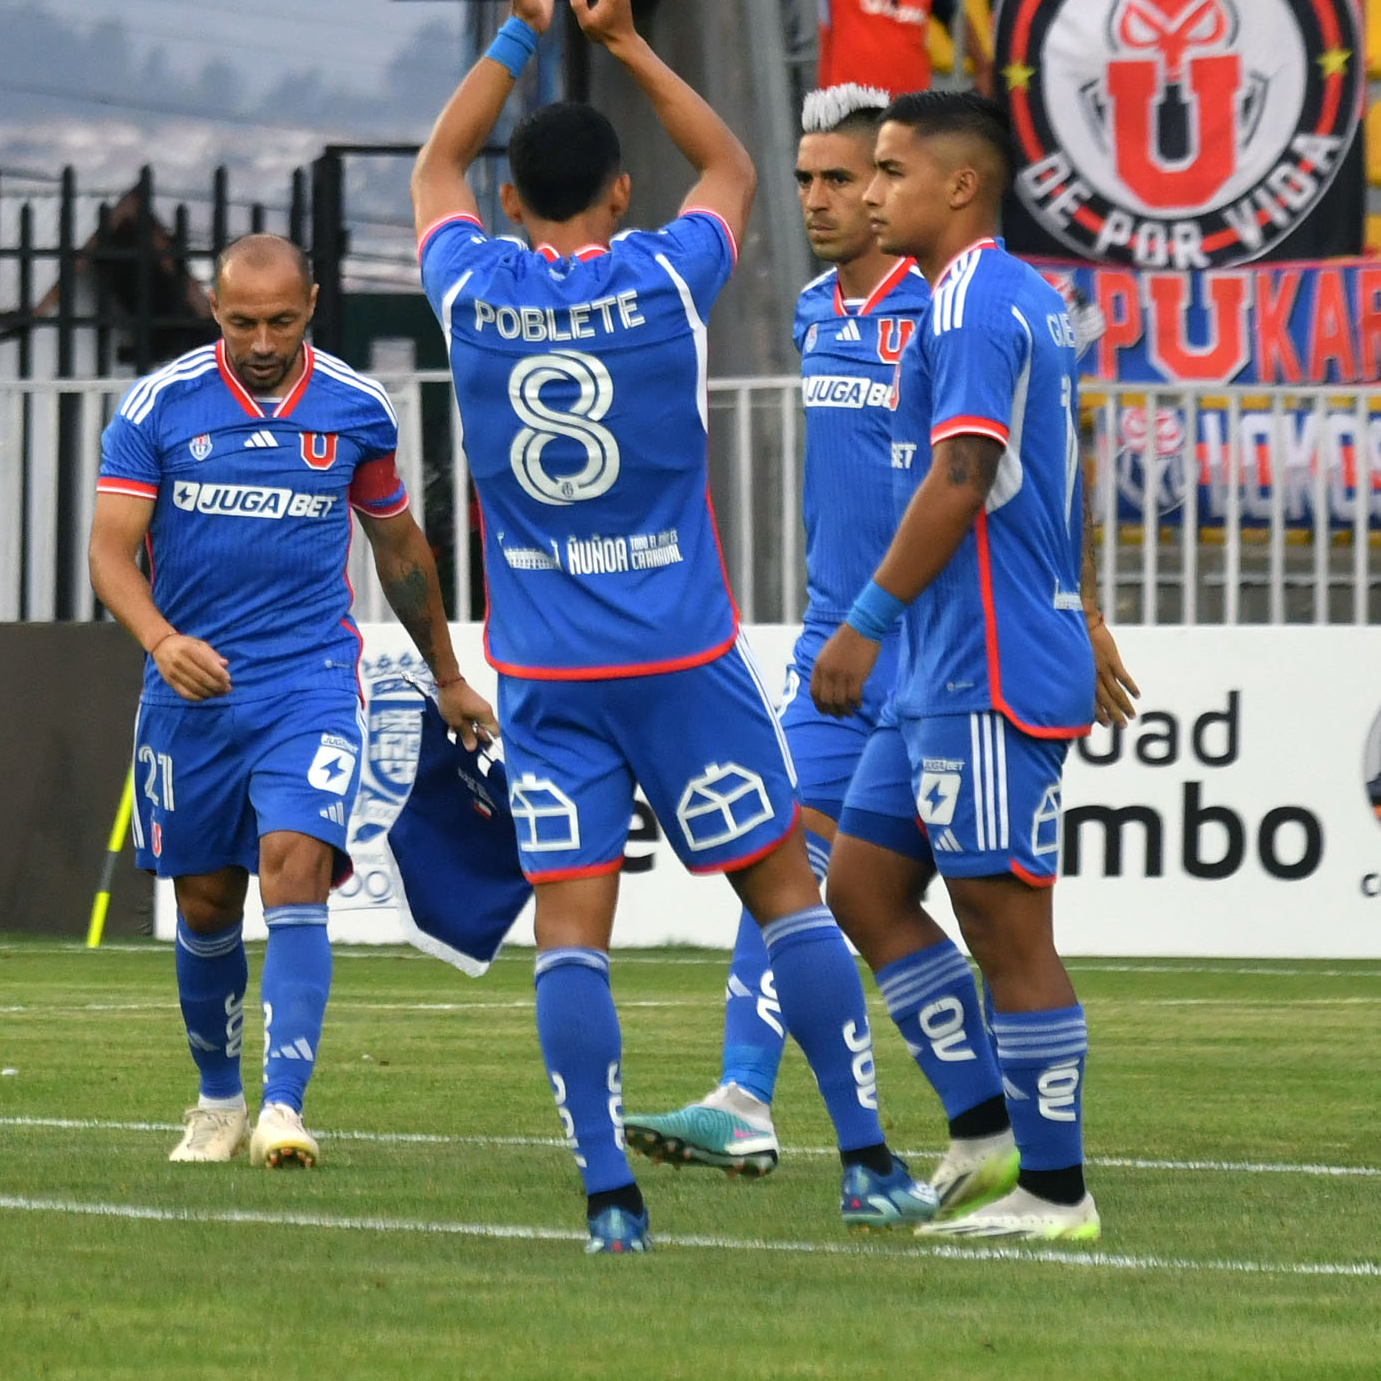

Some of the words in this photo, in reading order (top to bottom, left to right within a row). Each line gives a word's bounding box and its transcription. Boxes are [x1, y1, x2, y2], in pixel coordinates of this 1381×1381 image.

[1106, 54, 1243, 211] U
[1016, 151, 1094, 228] DE
[1097, 212, 1211, 269] POR
[1223, 132, 1343, 251] VIDA
[474, 289, 646, 342] POBLETE
[508, 348, 621, 506] 8
[567, 532, 629, 575] ÑUÑOA
[138, 745, 175, 812] 21
